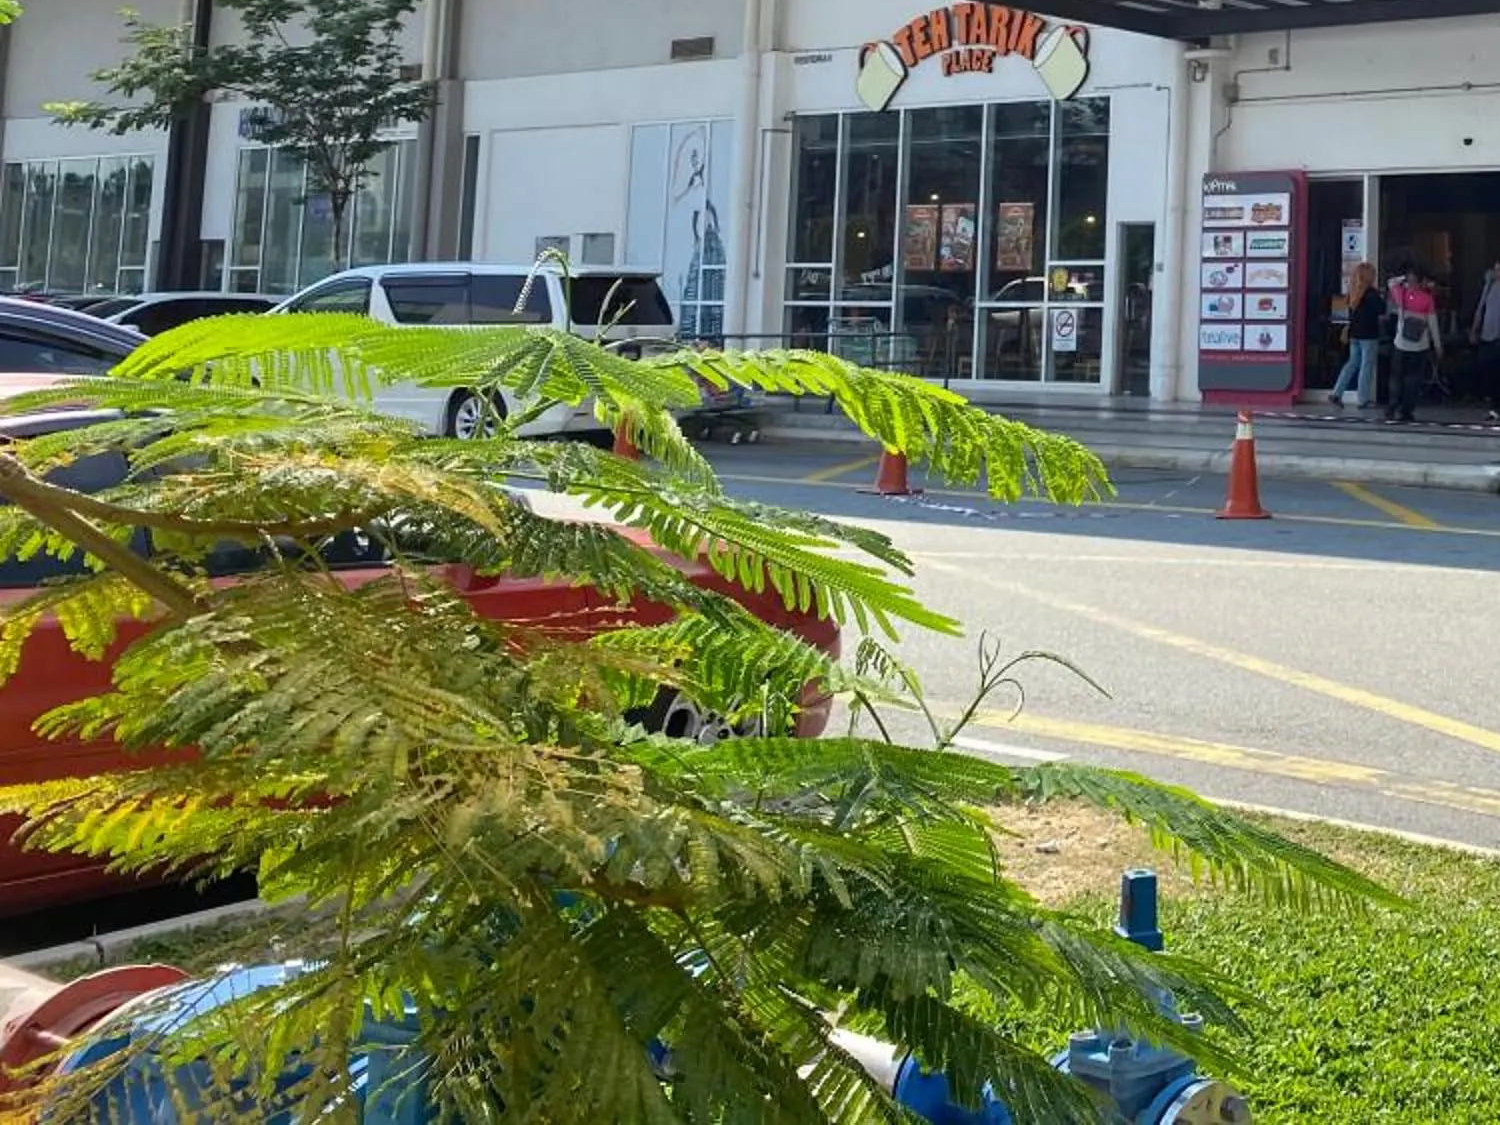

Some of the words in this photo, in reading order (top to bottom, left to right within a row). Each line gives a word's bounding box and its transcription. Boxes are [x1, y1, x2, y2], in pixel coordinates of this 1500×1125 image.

[894, 7, 952, 68] TEH
[952, 2, 1046, 61] TARIK
[941, 49, 996, 77] PLACE
